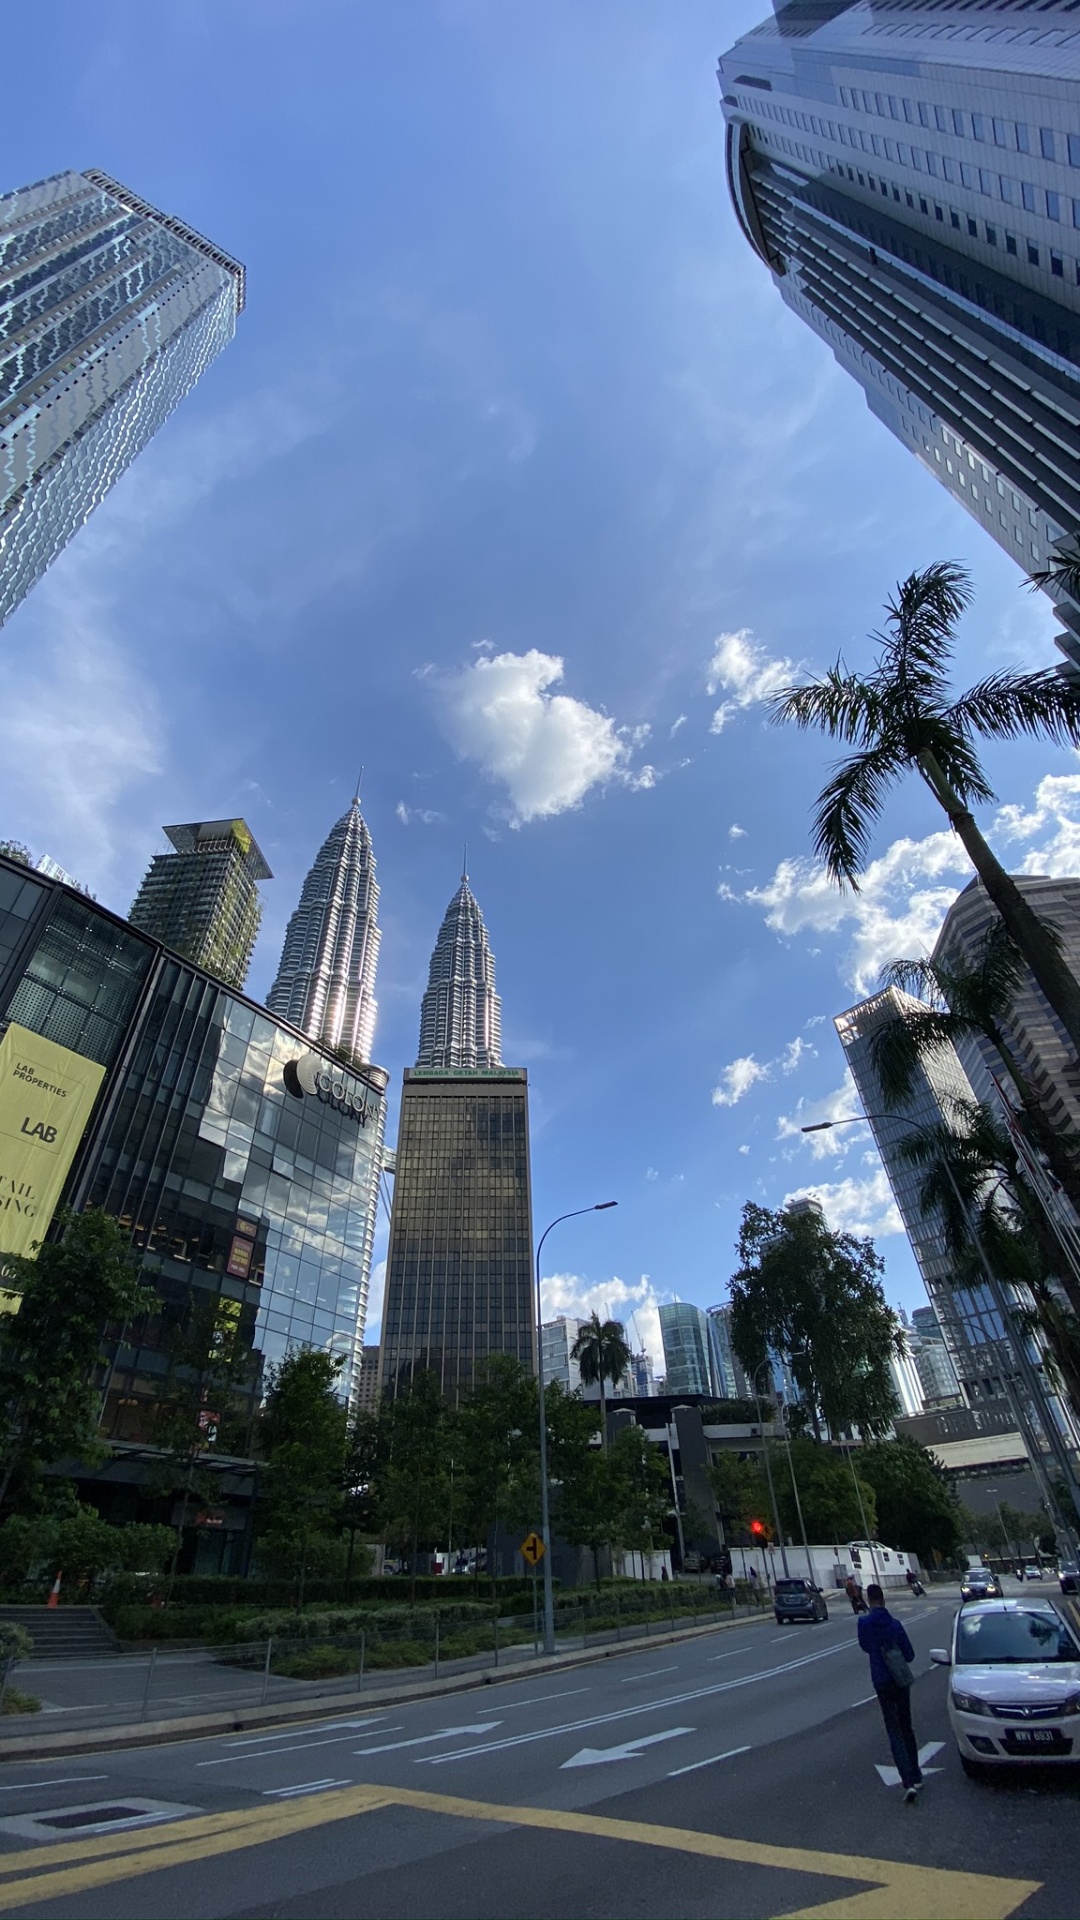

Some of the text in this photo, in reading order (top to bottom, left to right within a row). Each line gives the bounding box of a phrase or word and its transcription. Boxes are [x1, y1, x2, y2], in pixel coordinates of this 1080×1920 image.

[16, 1062, 35, 1075] LAB
[12, 1069, 68, 1098] PROPERTIES
[20, 1116, 58, 1143] LAB
